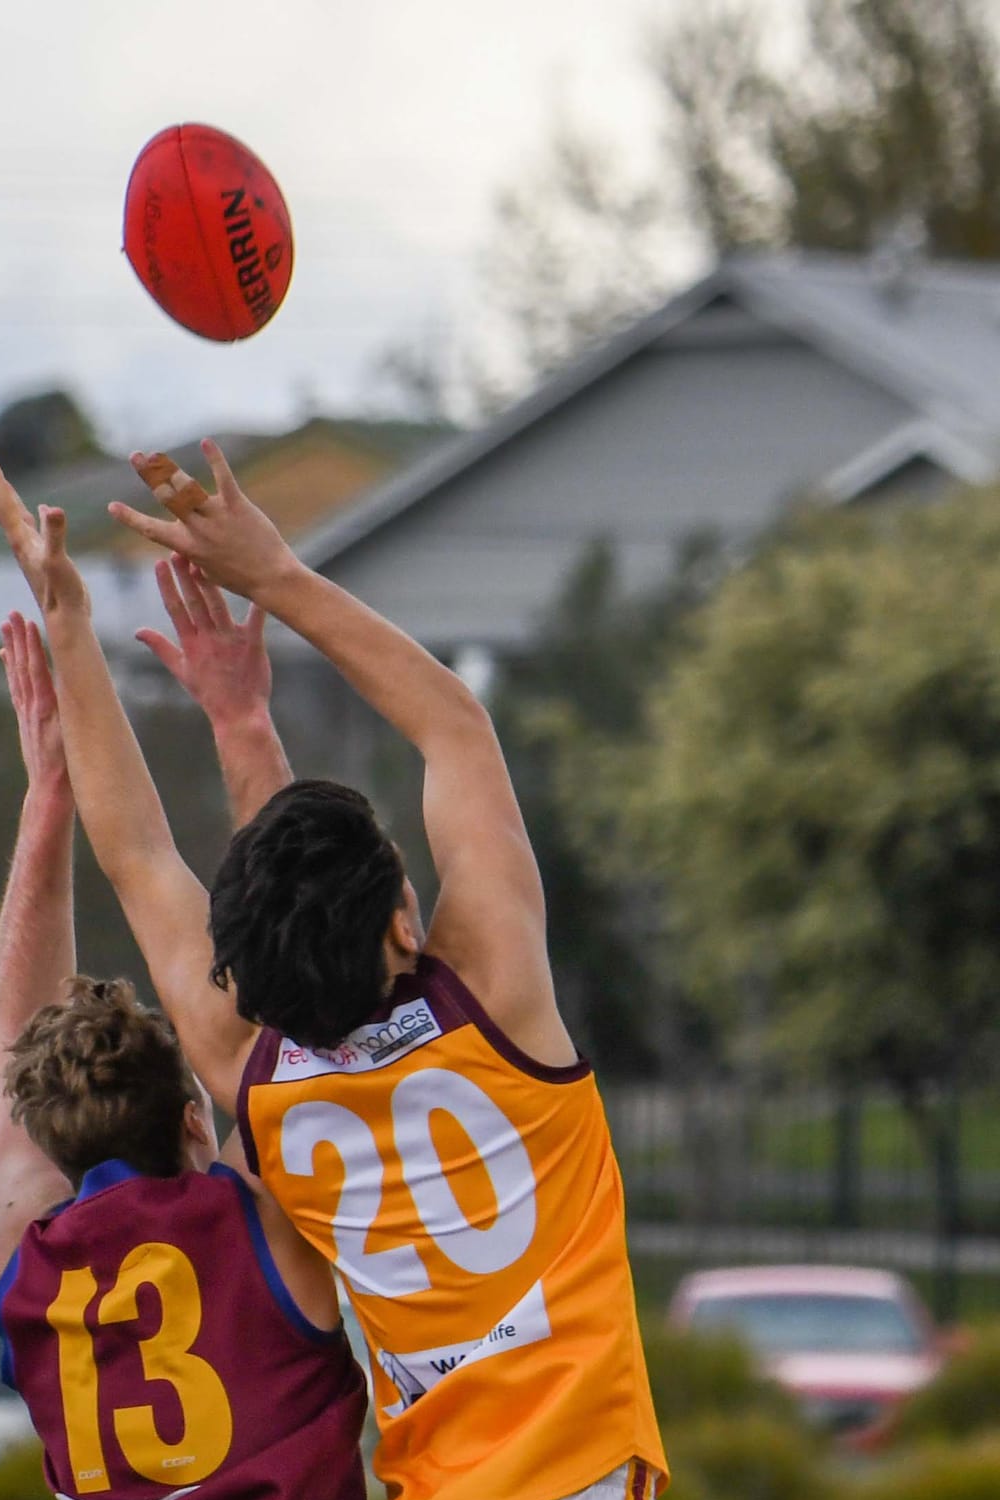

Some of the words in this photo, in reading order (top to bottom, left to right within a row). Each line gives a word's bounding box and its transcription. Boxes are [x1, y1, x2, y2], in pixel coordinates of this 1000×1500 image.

[221, 188, 275, 323] HERRIN
[354, 1008, 429, 1054] homes
[280, 1067, 537, 1298] 20
[46, 1242, 233, 1494] 13
